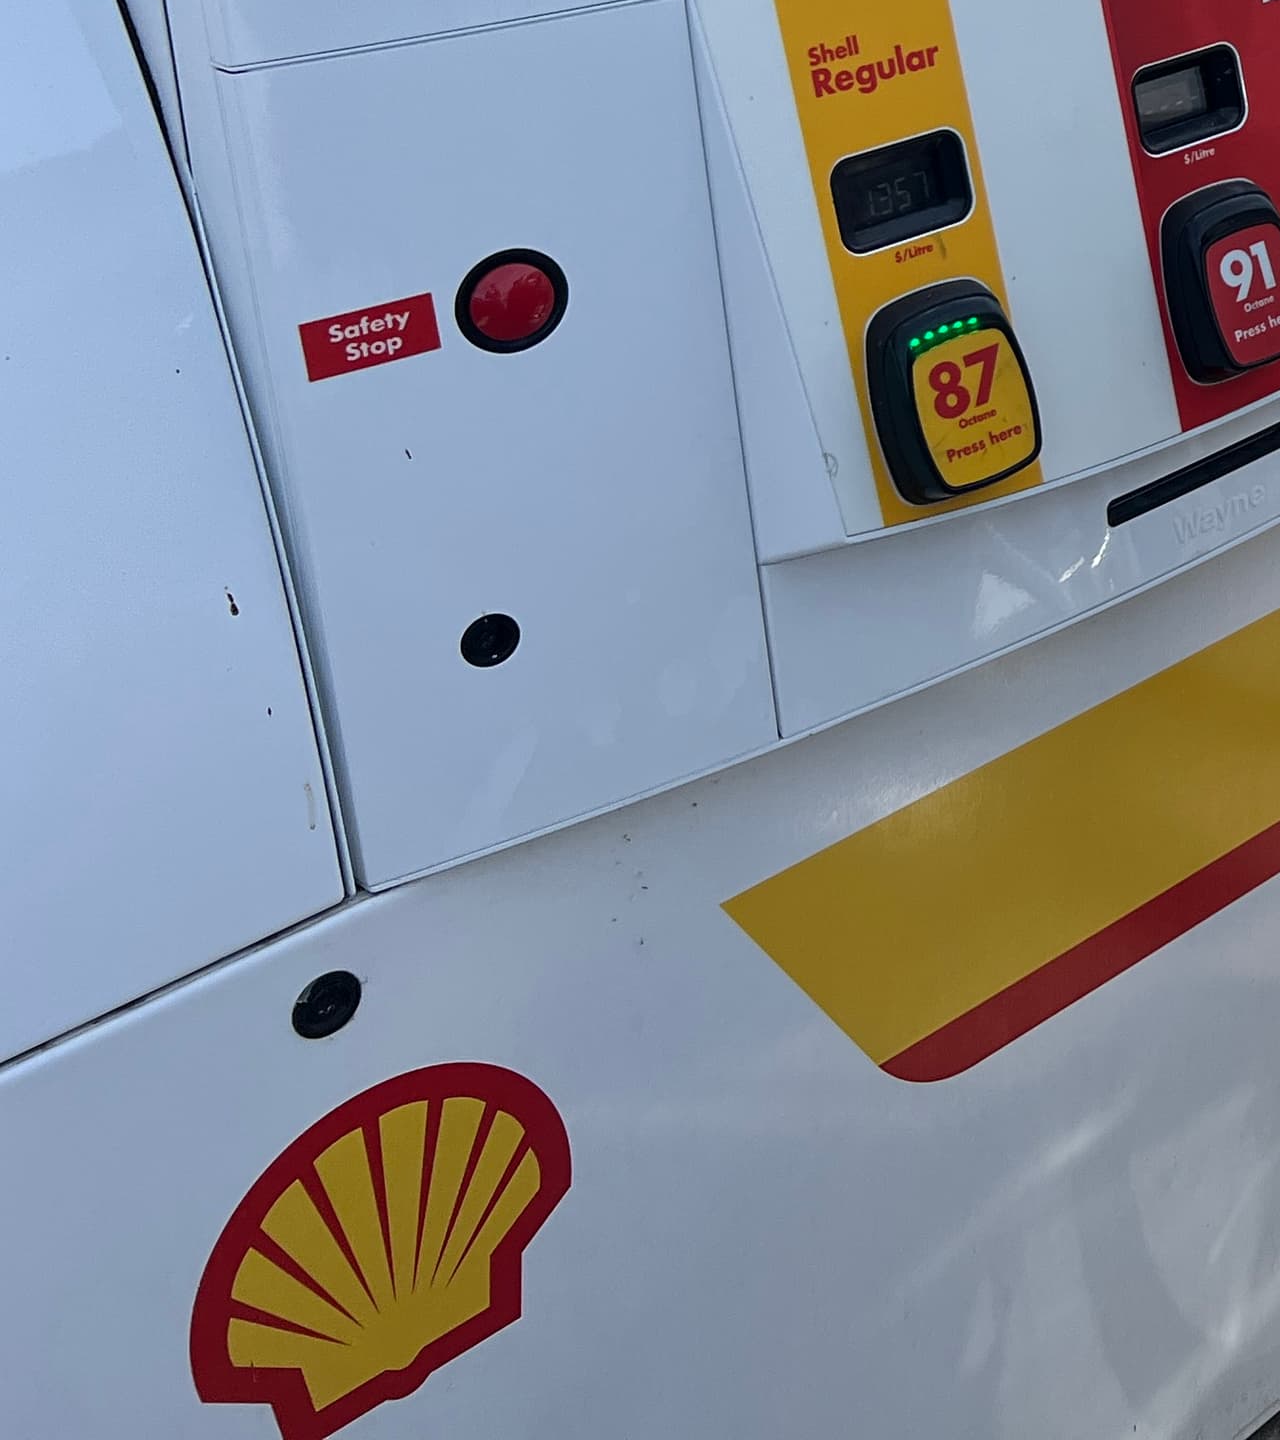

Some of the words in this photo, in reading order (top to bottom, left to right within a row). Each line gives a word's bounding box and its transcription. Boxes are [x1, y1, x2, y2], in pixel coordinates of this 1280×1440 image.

[807, 34, 860, 67] Shell
[809, 44, 940, 98] Regular
[1184, 147, 1216, 165] $/Litre
[895, 243, 934, 263] $/Litre
[1220, 240, 1277, 303] 91
[1243, 295, 1275, 313] Octane
[328, 310, 411, 344] Safety
[1234, 322, 1267, 343] Press
[345, 335, 403, 362] Stop
[928, 343, 1000, 420] 87
[958, 409, 998, 429] Octane
[946, 439, 986, 463] Press
[988, 425, 1023, 445] here
[1172, 484, 1266, 544] Wayne
